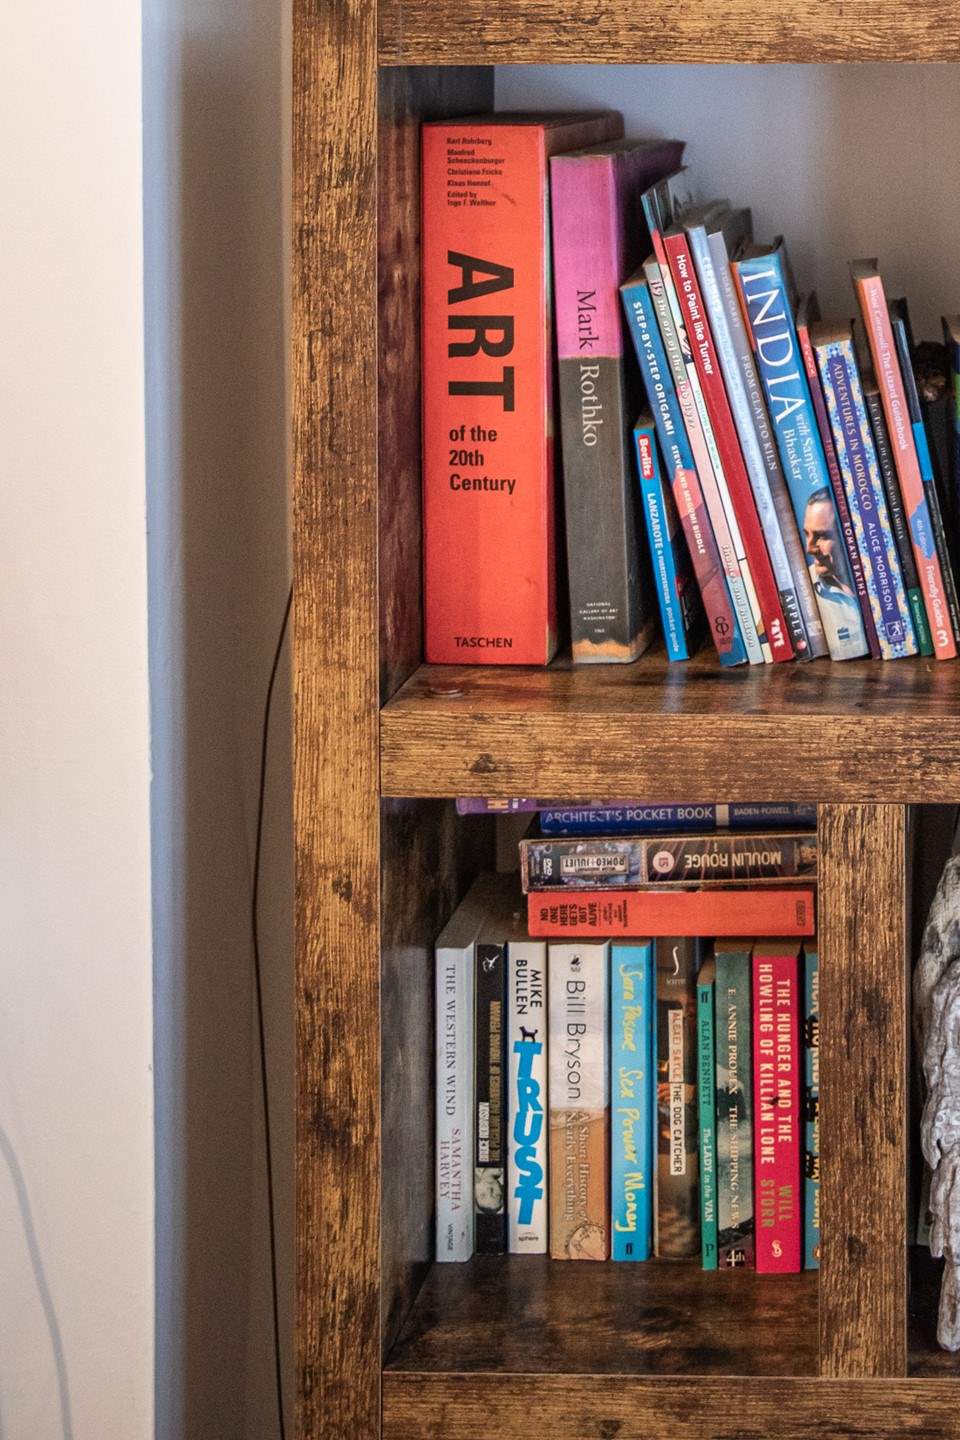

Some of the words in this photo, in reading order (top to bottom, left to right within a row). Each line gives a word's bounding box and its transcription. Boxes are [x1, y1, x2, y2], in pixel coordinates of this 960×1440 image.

[676, 254, 688, 278] How
[683, 279, 693, 292] to
[870, 287, 880, 309] West
[577, 289, 600, 350] Mark
[686, 293, 699, 320] Paint
[448, 250, 516, 412] ART
[633, 301, 660, 380] STEP-BY-STEP
[693, 322, 704, 340] like
[741, 268, 807, 424] INDIA
[699, 340, 714, 375] Turner
[881, 351, 891, 369] The
[833, 363, 856, 435] ADVENTURES
[885, 370, 898, 398] Lizard
[579, 363, 603, 447] Rothko
[654, 383, 675, 435] ORIGAMI
[449, 424, 466, 442] of
[471, 424, 498, 442] the
[796, 413, 811, 437] with
[891, 399, 909, 450] Guidebook
[449, 450, 485, 467] 20th
[671, 444, 683, 469] STEVE
[782, 429, 803, 480] Bhaskar
[826, 440, 835, 457] THE
[849, 438, 859, 451] IN
[803, 437, 821, 486] Sanjeev
[450, 473, 517, 495] Century
[679, 471, 691, 488] AND
[829, 463, 848, 518] ESSENTIAL
[853, 454, 872, 510] MOROCCO
[684, 490, 698, 524] MEGUMI
[693, 525, 706, 554] BIDDLE
[843, 522, 858, 559] ROMAN
[868, 521, 880, 553] ALICE
[853, 563, 867, 596] BATHS
[874, 556, 894, 611] MORRISON
[925, 565, 940, 599] Friendly
[784, 593, 802, 637] APPLE
[932, 599, 944, 628] Guides
[454, 637, 513, 649] TASCHEN
[769, 618, 785, 647] TATE
[544, 810, 623, 824] ARCHITECT'S
[626, 808, 672, 821] POCKET
[677, 807, 713, 819] BOOK
[684, 853, 728, 868] ROUGE
[731, 851, 782, 866] MOULIN
[568, 903, 577, 926] GETS
[446, 964, 456, 994] THE
[516, 959, 528, 1015] BULLEN
[530, 969, 542, 1007] MIKE
[619, 964, 643, 1000] Sara
[727, 988, 736, 998] E.
[777, 979, 791, 1006] THE
[566, 980, 586, 1013] Bill
[759, 964, 773, 1032] HOWLING
[446, 1000, 456, 1069] WESTERN
[701, 1020, 710, 1051] ALAN
[728, 1003, 737, 1040] ANNIE
[760, 1039, 774, 1056] OF
[777, 1013, 791, 1072] HUNGER
[564, 1023, 586, 1099] Bryson
[728, 1045, 737, 1095] PROULX
[446, 1074, 456, 1116] WIND
[619, 1067, 643, 1098] Sex
[673, 1085, 682, 1103] THE
[702, 1055, 711, 1107] BENNETT
[760, 1063, 774, 1121] KILLIAN
[777, 1079, 792, 1108] AND
[513, 1040, 544, 1224] TRUST
[562, 1112, 577, 1152] Nearly
[578, 1112, 590, 1121] A
[673, 1107, 682, 1125] DOG
[729, 1107, 738, 1128] THE
[778, 1115, 792, 1142] THE
[578, 1127, 590, 1159] Short
[617, 1108, 641, 1165] Power
[673, 1129, 682, 1173] CATCHER
[703, 1128, 711, 1144] The
[761, 1128, 775, 1164] LONE
[440, 1140, 450, 1199] HARVEY
[451, 1127, 461, 1212] SAMANTHA
[703, 1145, 712, 1172] LADY
[730, 1134, 738, 1190] SHIPPING
[561, 1156, 577, 1221] Everything
[576, 1163, 590, 1207] History
[704, 1174, 712, 1183] in
[704, 1184, 712, 1199] the
[578, 1211, 590, 1222] of
[614, 1171, 646, 1232] Money
[703, 1200, 713, 1222] VAN
[730, 1194, 739, 1229] NEWS
[761, 1179, 775, 1228] STORR
[779, 1184, 793, 1222] WILL
